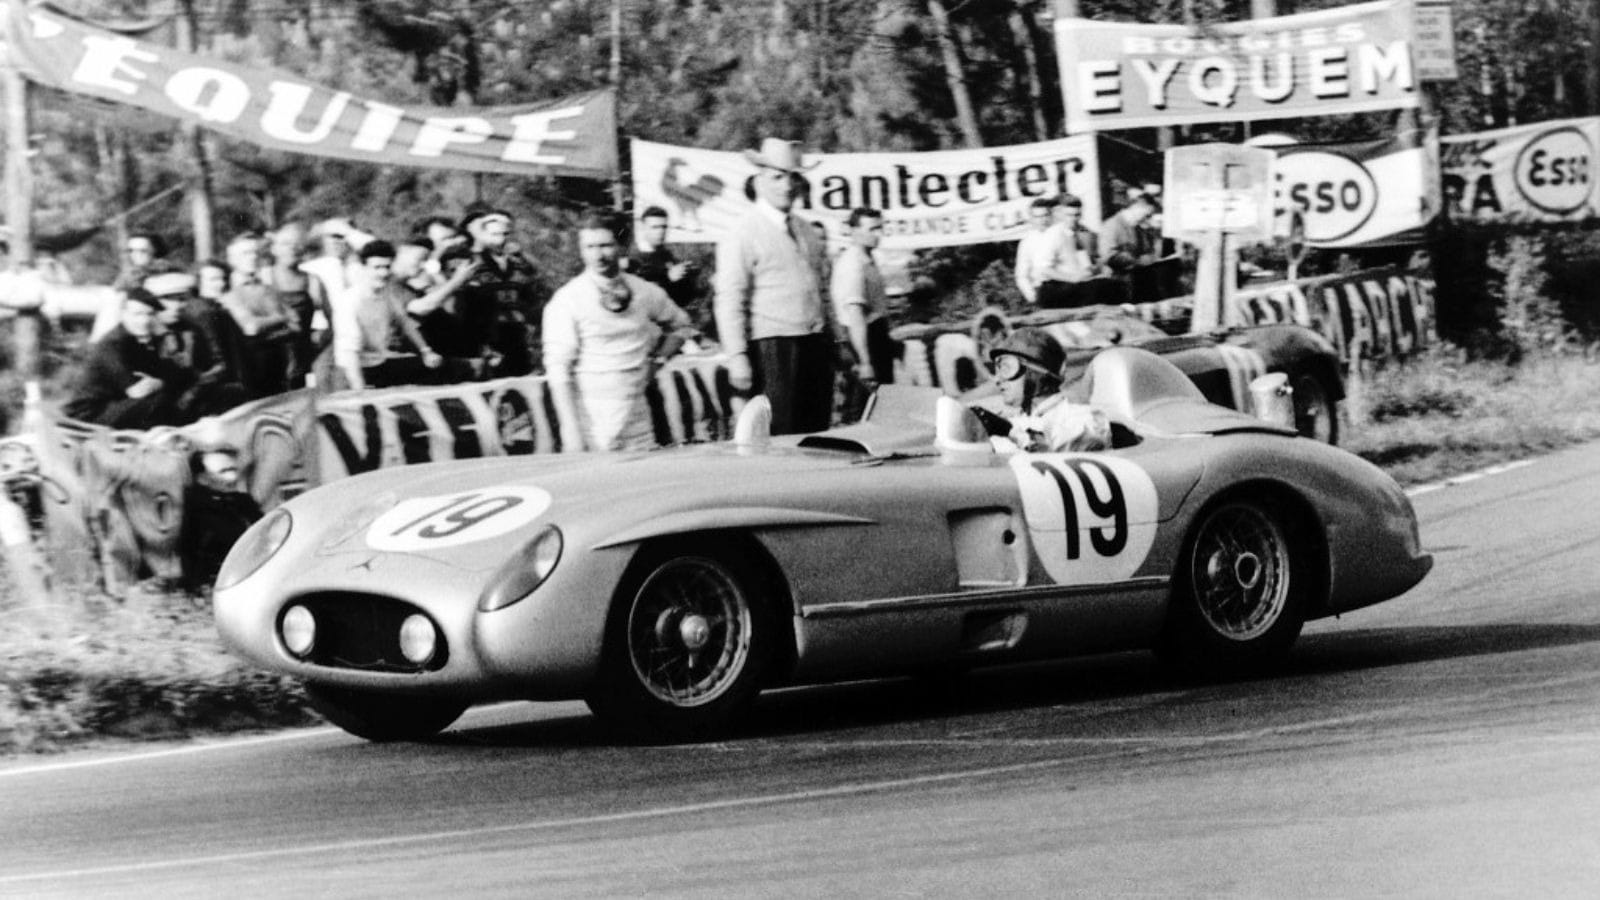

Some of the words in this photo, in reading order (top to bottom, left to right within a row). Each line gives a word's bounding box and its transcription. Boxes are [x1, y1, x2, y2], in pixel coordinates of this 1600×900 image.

[1078, 41, 1415, 115] EYQUEM
[389, 493, 525, 539] 19
[1030, 457, 1129, 560] 19
